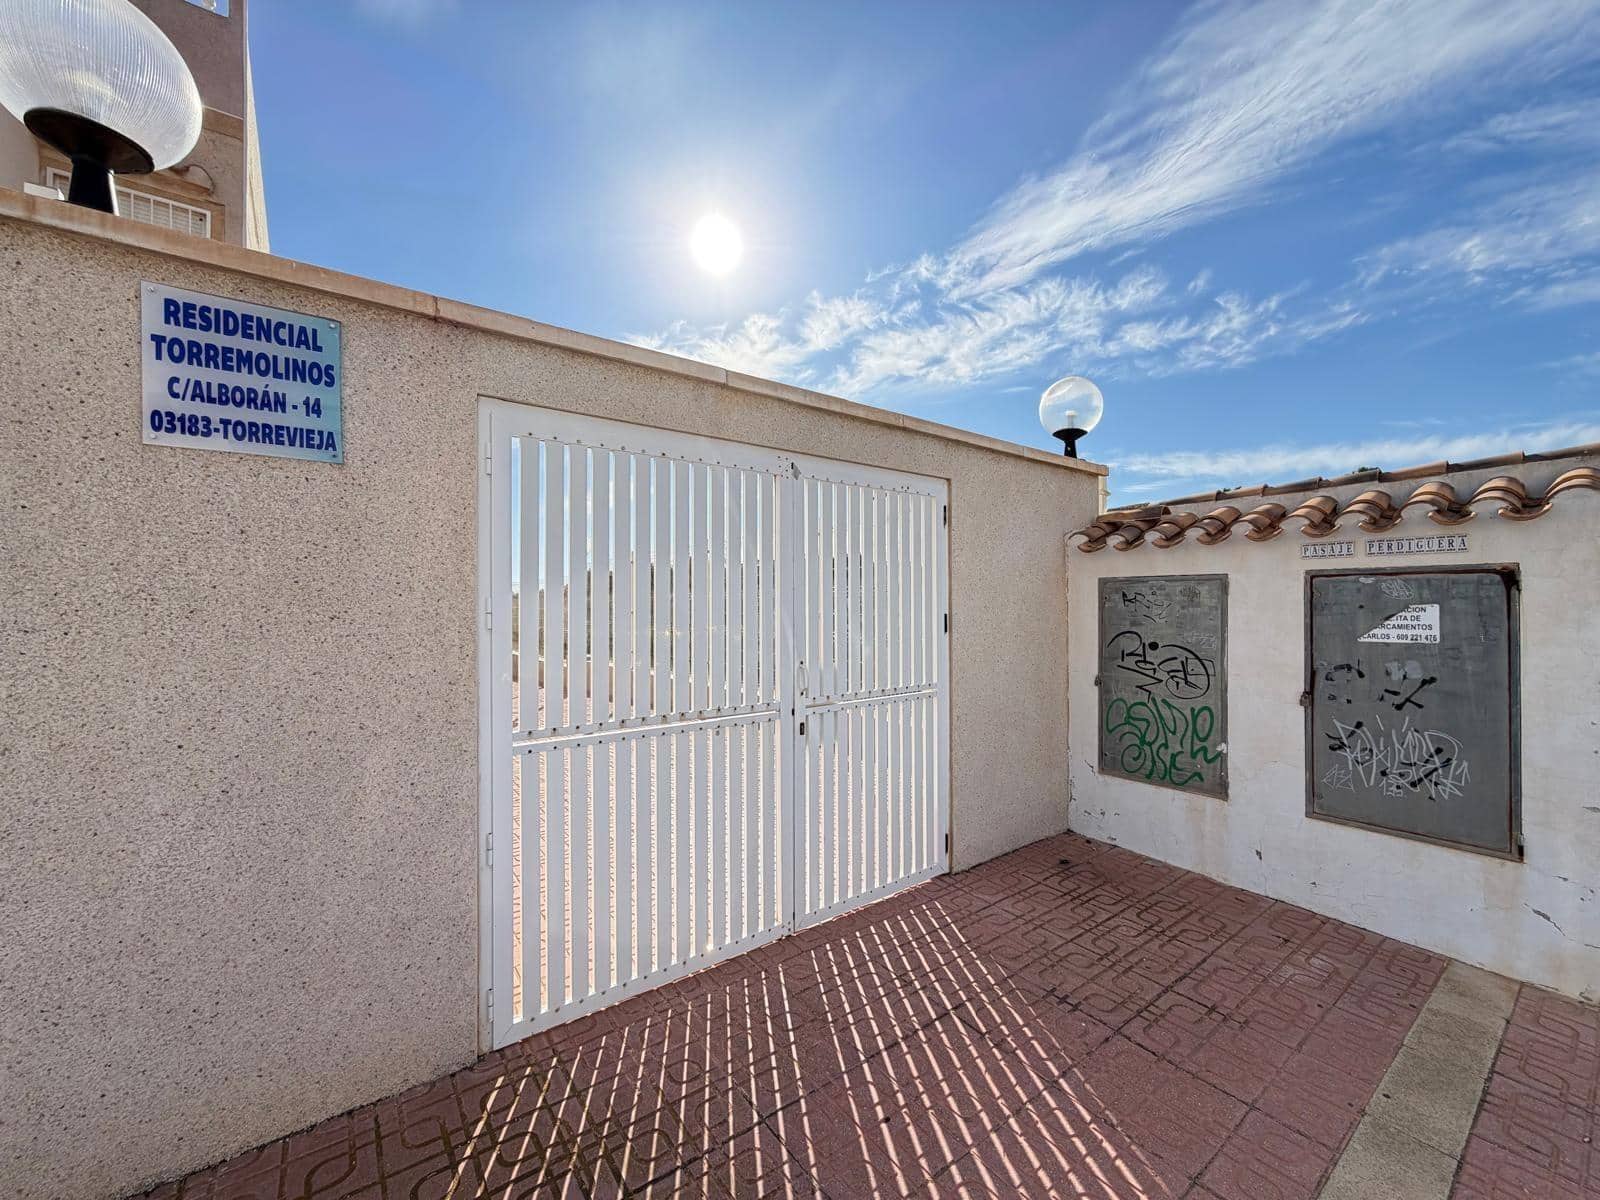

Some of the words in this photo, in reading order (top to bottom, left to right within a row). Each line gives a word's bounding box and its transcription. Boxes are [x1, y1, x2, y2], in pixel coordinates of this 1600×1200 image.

[163, 297, 323, 353] RESIDENCIAL
[150, 333, 336, 388] TORREMOLINOS
[167, 376, 287, 414] C/ALBORÁN
[302, 396, 322, 419] 14
[150, 409, 337, 452] 03183-TORREVIEJA
[1303, 545, 1353, 556] PASAJE
[1367, 538, 1467, 553] PERDIGUERA
